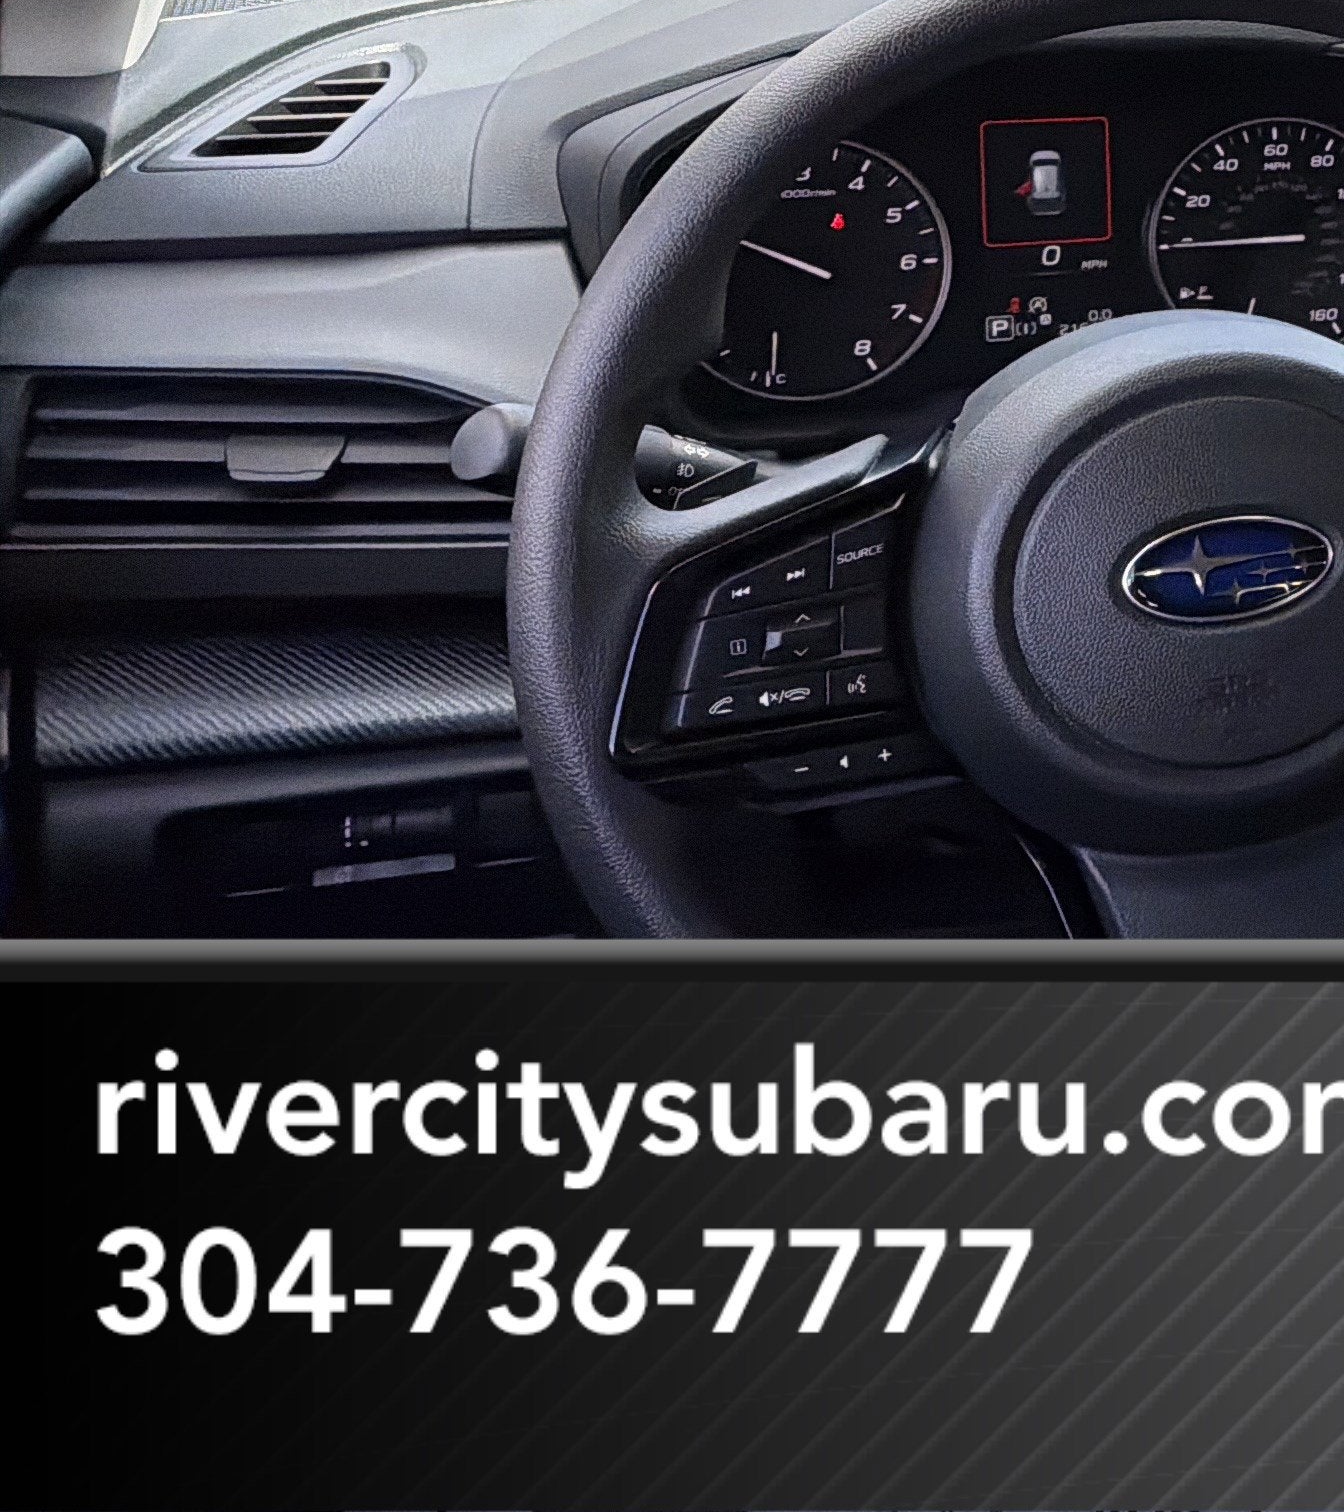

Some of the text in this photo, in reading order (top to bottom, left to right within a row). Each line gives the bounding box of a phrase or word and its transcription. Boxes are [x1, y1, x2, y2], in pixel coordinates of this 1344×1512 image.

[1263, 143, 1289, 157] 60
[1212, 157, 1239, 172] 40
[1263, 160, 1291, 171] MPH
[1310, 154, 1335, 168] 80
[848, 175, 865, 191] 4
[1185, 194, 1211, 209] 20
[885, 207, 902, 223] 5
[900, 254, 918, 271] 6
[1041, 245, 1061, 267] 0
[890, 303, 907, 320] 7
[1309, 307, 1339, 322] 160
[991, 319, 1010, 337] P
[853, 339, 872, 356] 8
[836, 541, 885, 566] SOURCE
